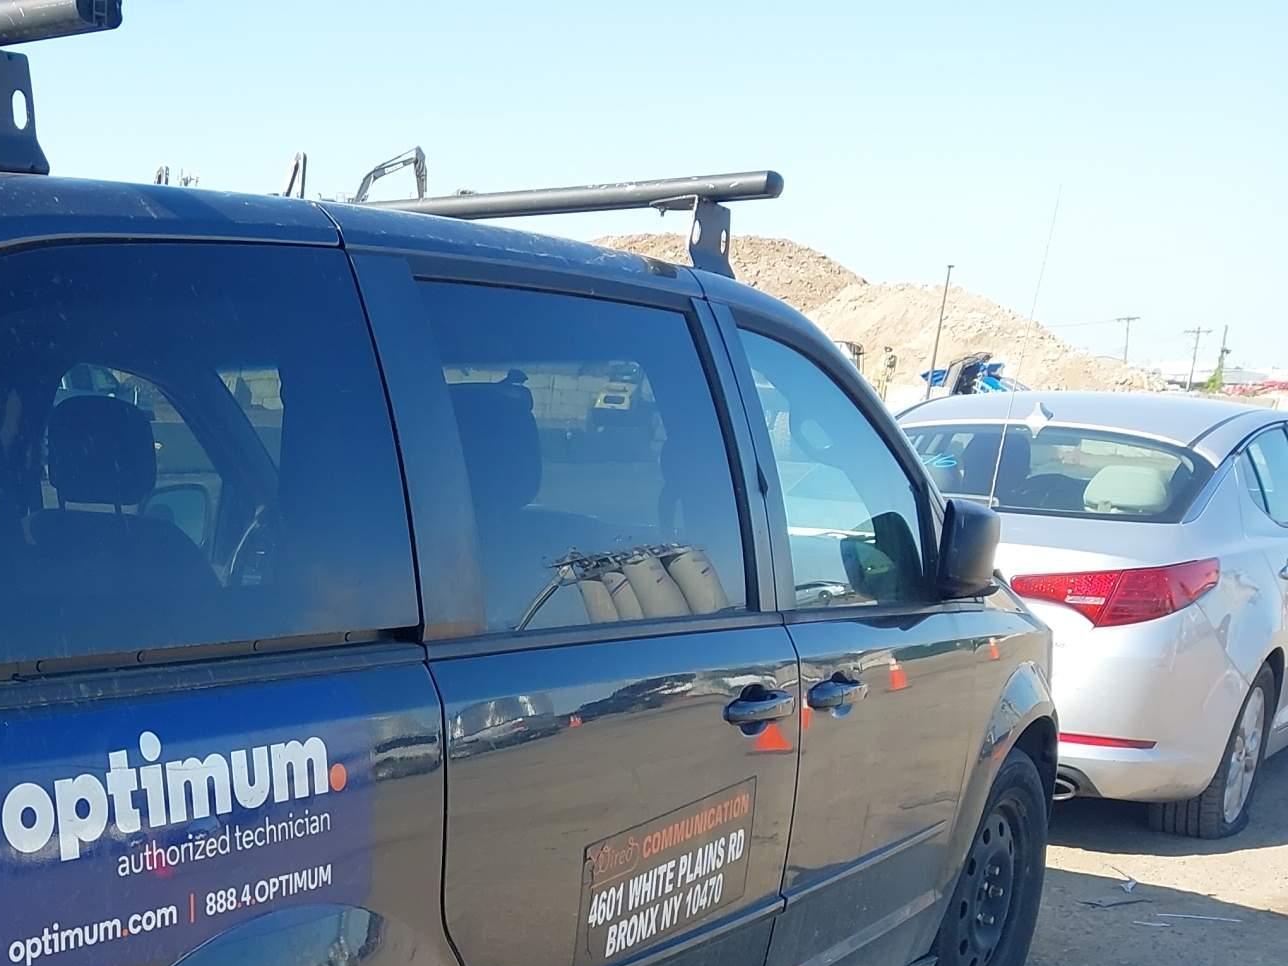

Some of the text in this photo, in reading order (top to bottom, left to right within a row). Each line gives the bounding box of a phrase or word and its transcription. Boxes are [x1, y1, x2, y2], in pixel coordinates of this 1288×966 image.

[118, 809, 331, 876] authorized technician
[642, 793, 750, 859] COMMUNICATION
[9, 863, 332, 966] optimum.com 888.4.OPTIMUM
[587, 828, 746, 928] 4601 WHITE PLAINS RD
[605, 873, 724, 958] BRONX NY 10470
